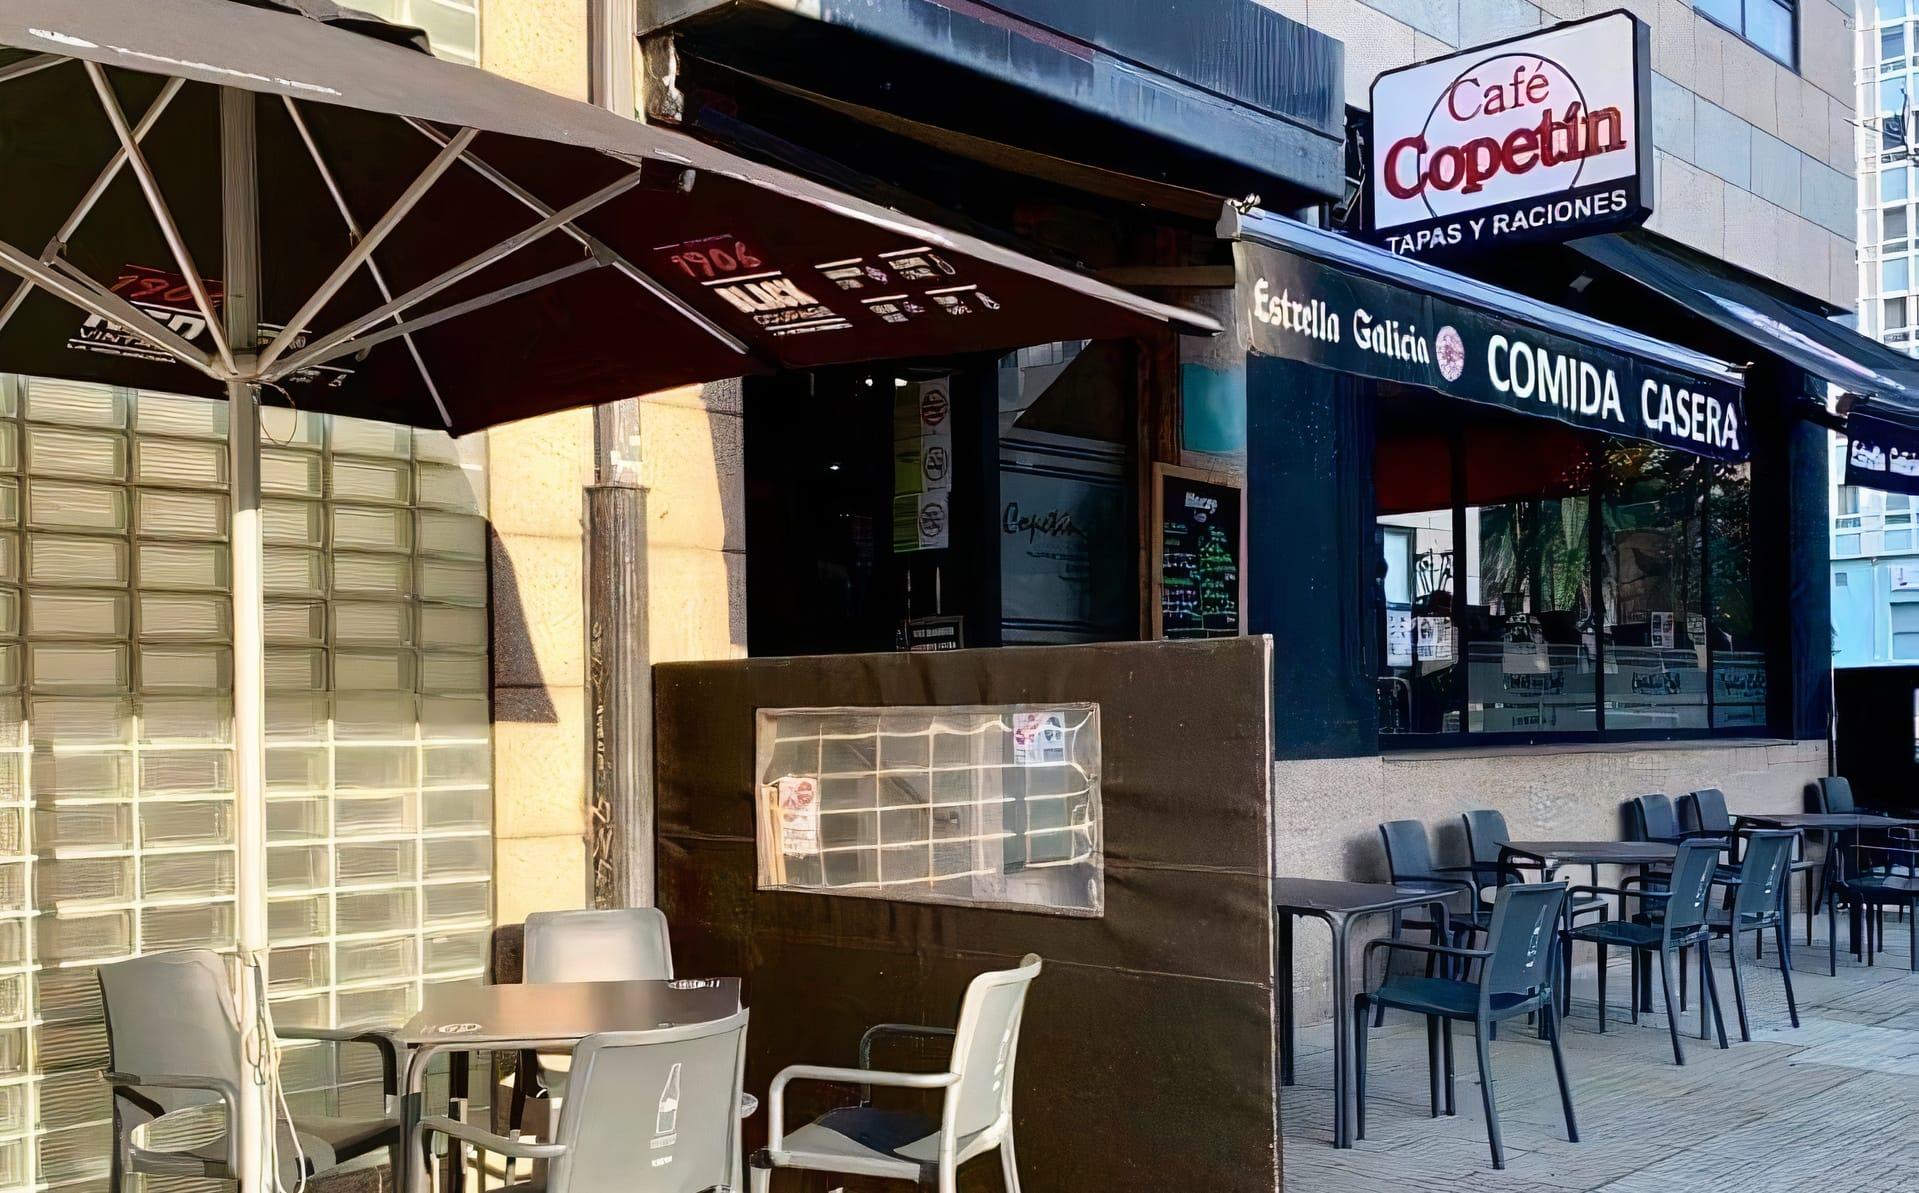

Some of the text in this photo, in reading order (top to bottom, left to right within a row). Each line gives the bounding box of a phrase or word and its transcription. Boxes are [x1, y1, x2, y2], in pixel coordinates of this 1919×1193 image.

[1449, 61, 1549, 121] Café
[1384, 101, 1627, 199] Copetín
[1386, 189, 1627, 257] TAPAS Y RACIONES
[671, 241, 761, 277] 1906
[1254, 277, 1740, 450] Estrella Galicia COMIDA CASERA
